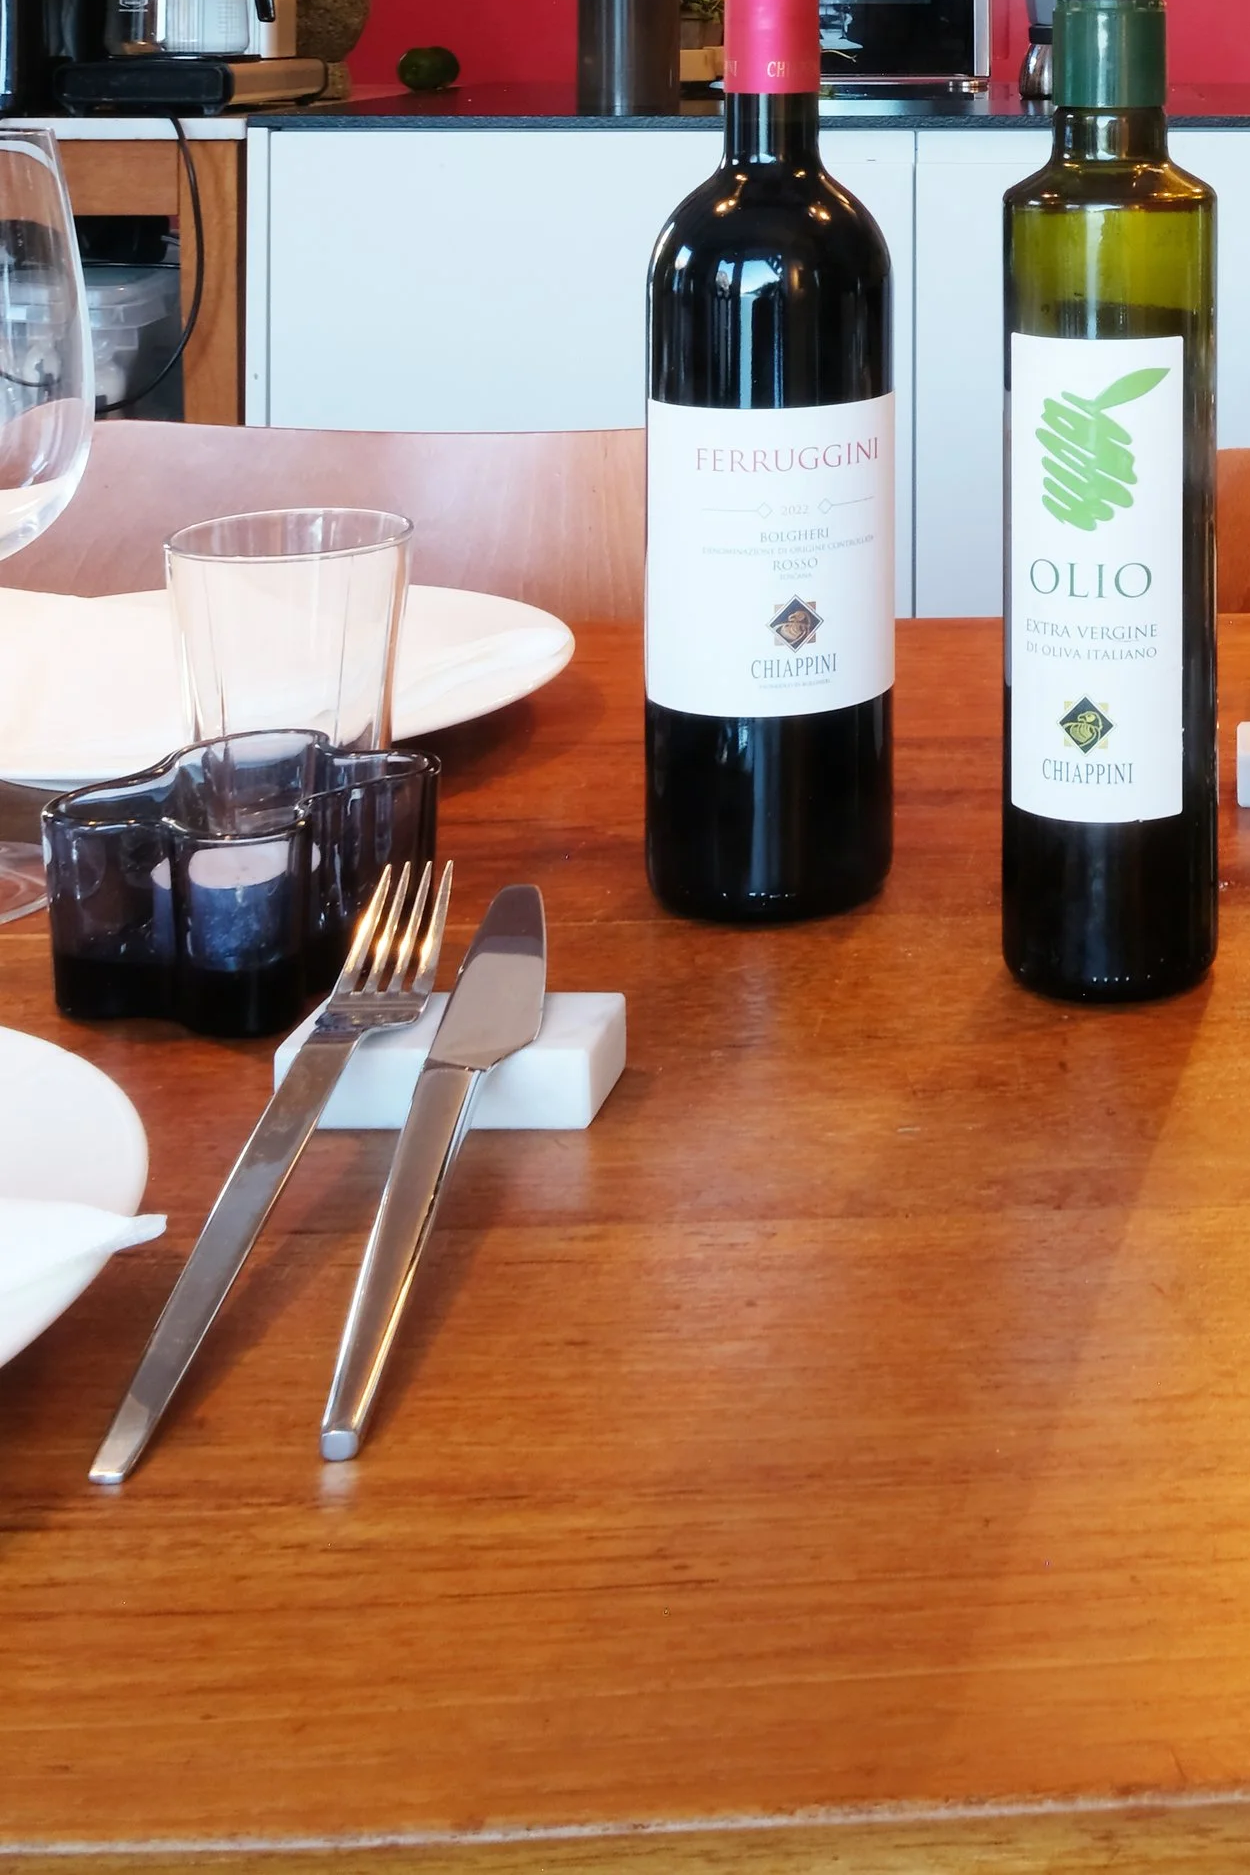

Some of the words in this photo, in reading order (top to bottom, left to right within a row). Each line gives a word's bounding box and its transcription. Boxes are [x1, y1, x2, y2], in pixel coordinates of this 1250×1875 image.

[696, 437, 878, 473] FERRUGGINI
[780, 504, 809, 517] 2022
[760, 527, 830, 543] BOLGHERI
[772, 557, 819, 572] ROSSO
[1030, 558, 1152, 598] OLIO
[1026, 618, 1072, 639] EXTRA
[1077, 624, 1158, 642] VERGINE
[1026, 641, 1038, 653] DI
[1042, 644, 1082, 660] OLIVA
[1087, 647, 1157, 660] ITALIANO
[751, 653, 838, 679] CHIAPPINI
[1042, 758, 1134, 785] CHIAPPINI
